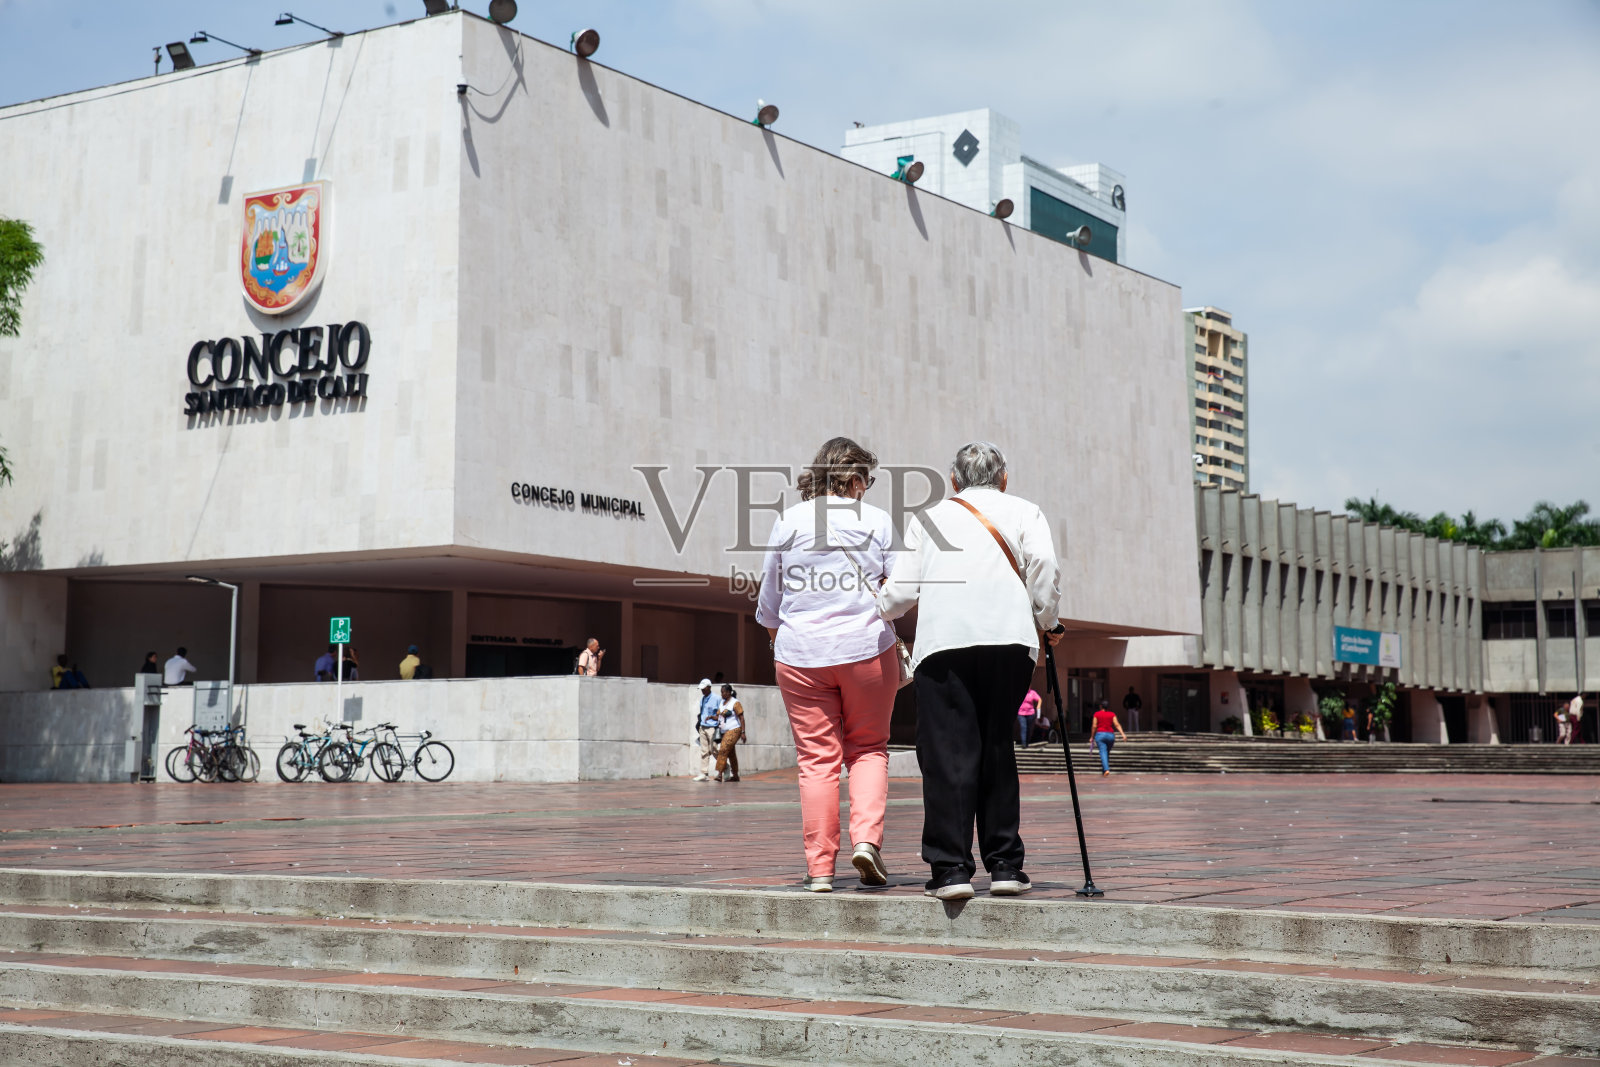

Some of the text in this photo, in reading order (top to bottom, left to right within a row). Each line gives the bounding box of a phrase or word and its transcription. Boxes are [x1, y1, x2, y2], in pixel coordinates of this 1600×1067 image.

[187, 320, 371, 387] CONCEJO
[184, 373, 369, 416] SANTIAGO DE CALI
[511, 482, 645, 517] CONCEJO MUNICIPAL
[339, 619, 344, 628] P
